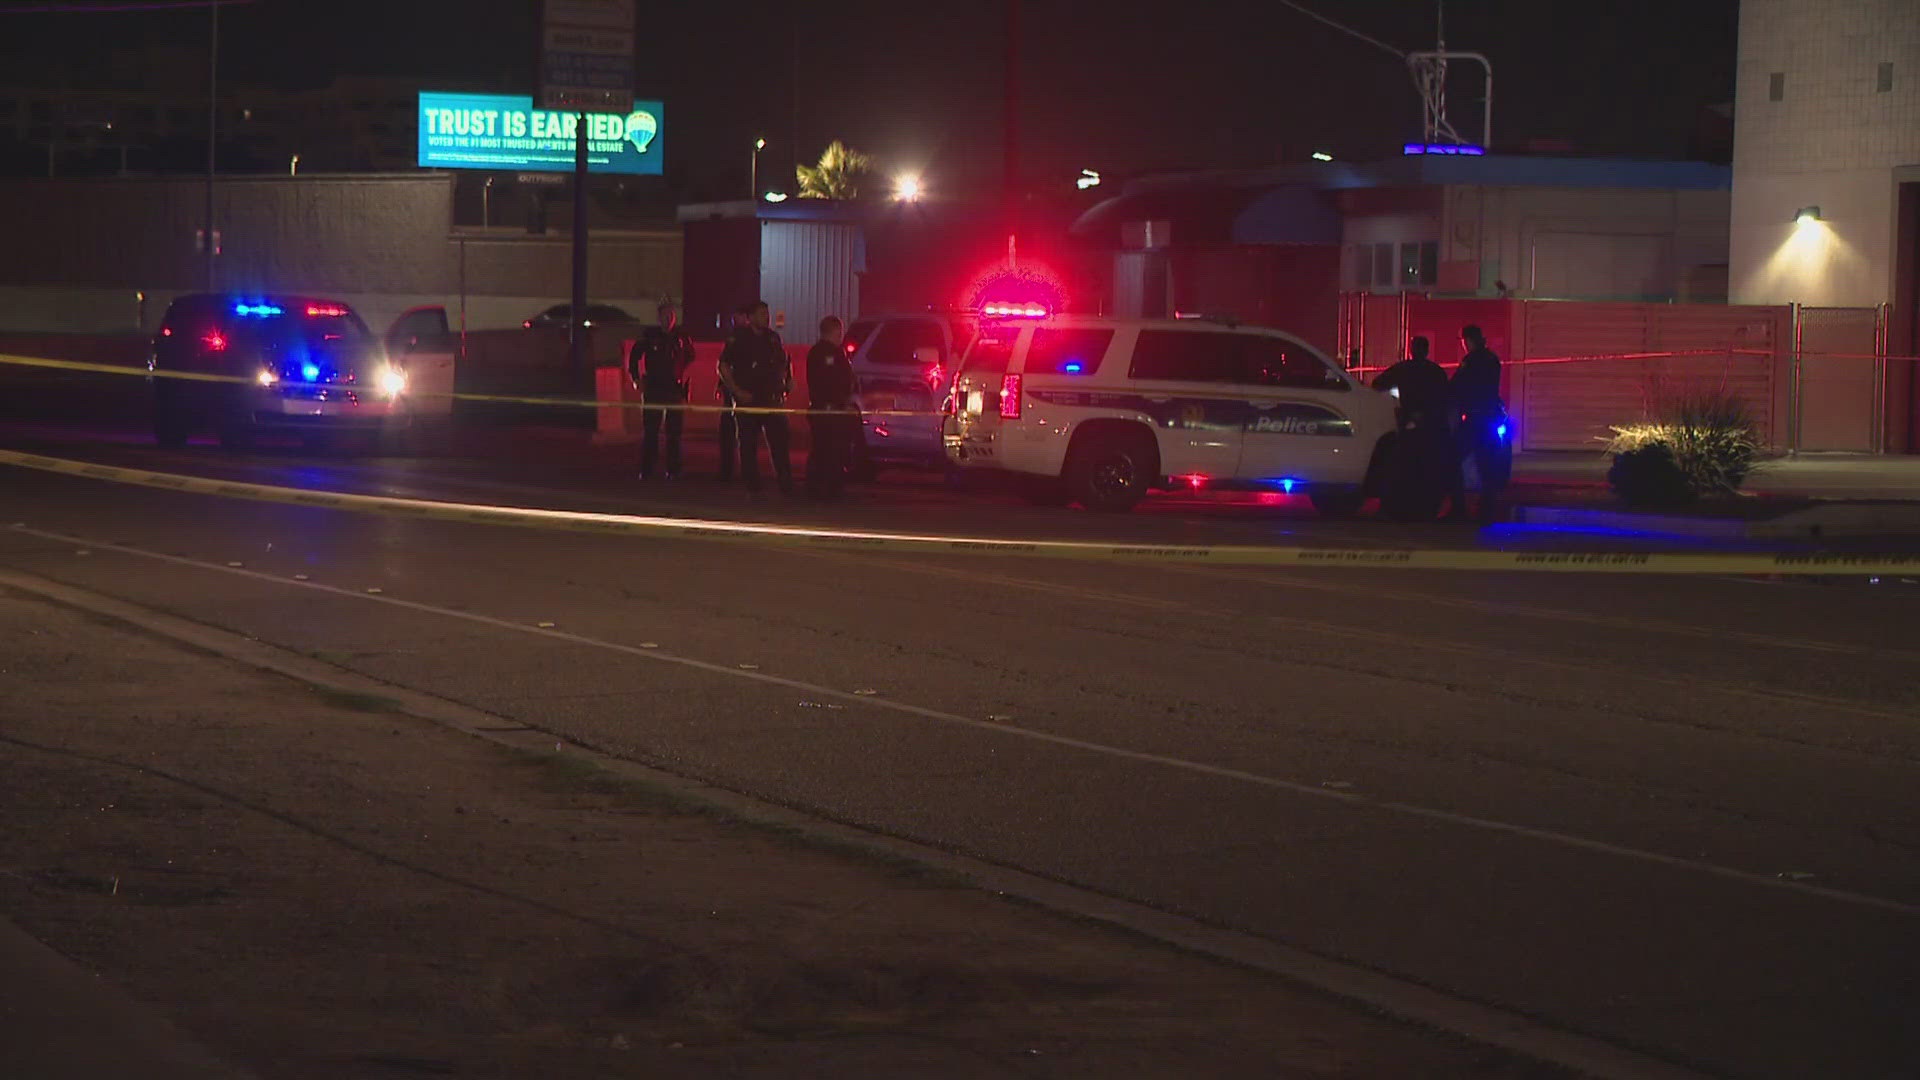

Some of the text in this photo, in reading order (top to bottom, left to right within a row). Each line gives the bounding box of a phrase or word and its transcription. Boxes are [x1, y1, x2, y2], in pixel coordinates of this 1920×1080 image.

[425, 108, 498, 136] TRUST
[503, 111, 526, 137] IS
[429, 136, 454, 147] VOTED
[455, 137, 467, 148] THE
[481, 138, 501, 149] MOST
[504, 138, 536, 150] TRUSTED
[597, 142, 624, 153] ESTATE
[1256, 416, 1318, 434] Police
